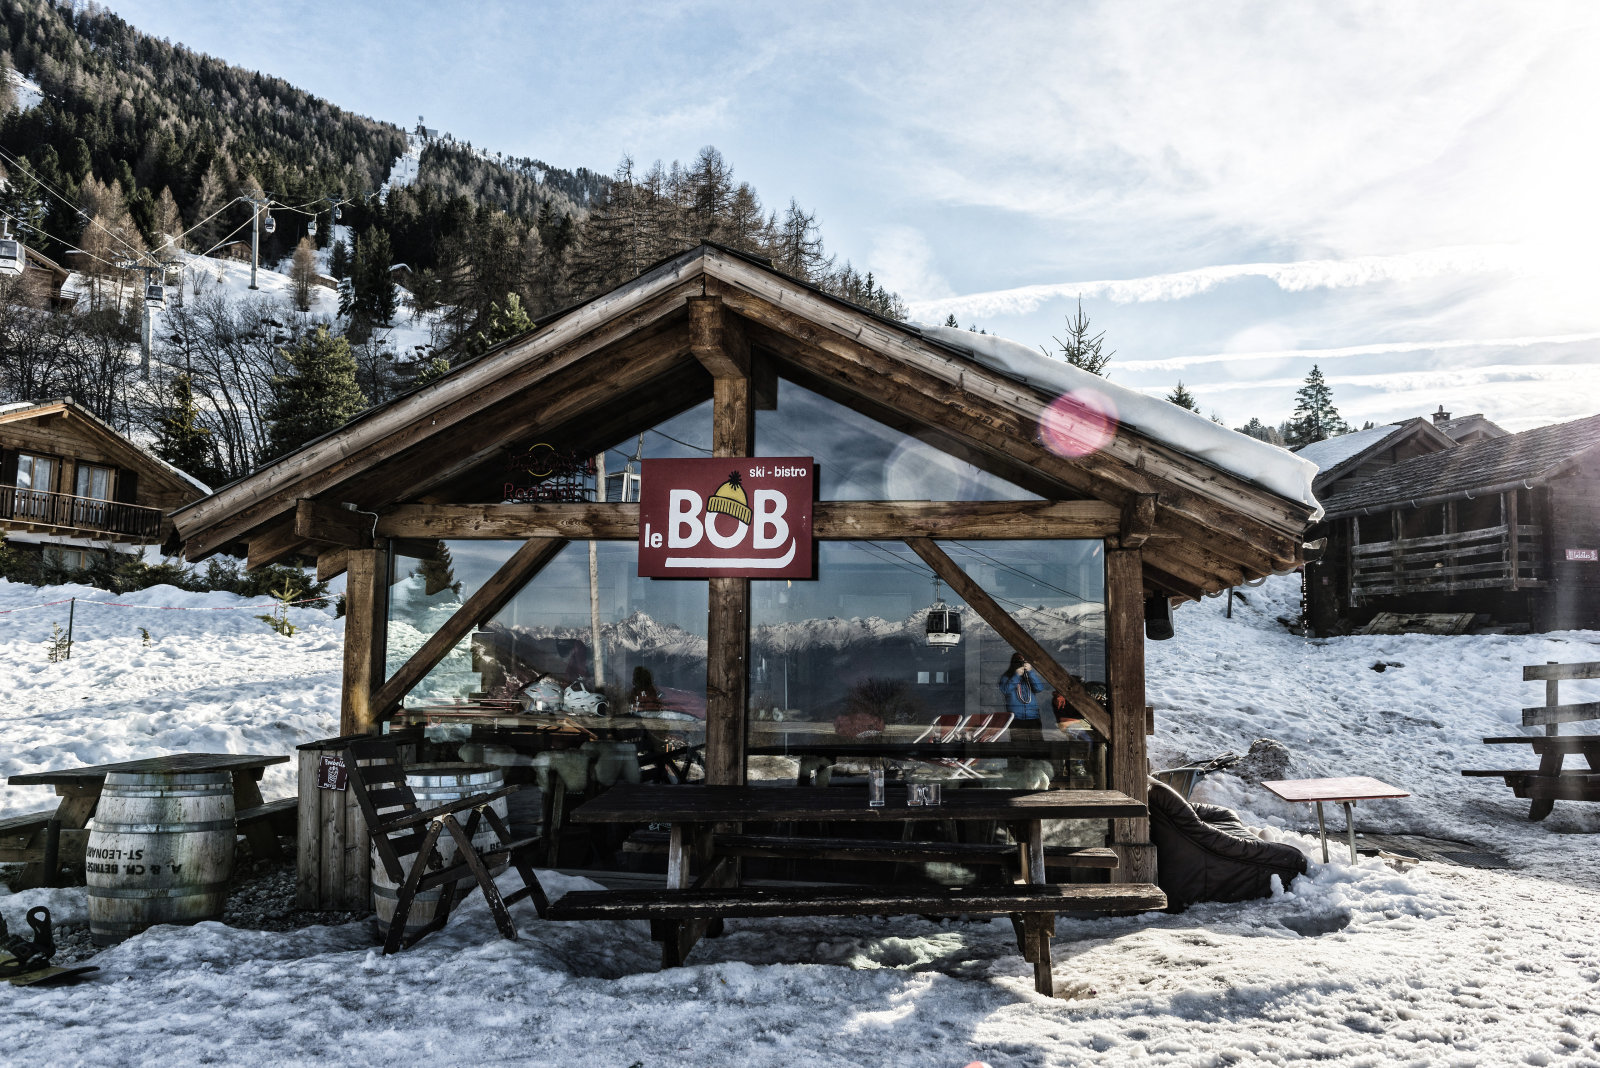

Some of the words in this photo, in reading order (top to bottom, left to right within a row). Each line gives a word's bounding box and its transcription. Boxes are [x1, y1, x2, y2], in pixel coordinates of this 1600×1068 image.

[749, 465, 765, 478] ski
[774, 465, 807, 478] bistro
[503, 483, 538, 500] Red
[542, 483, 576, 500] Bull
[644, 523, 663, 549] le
[667, 488, 790, 550] BOB
[150, 864, 161, 876] &
